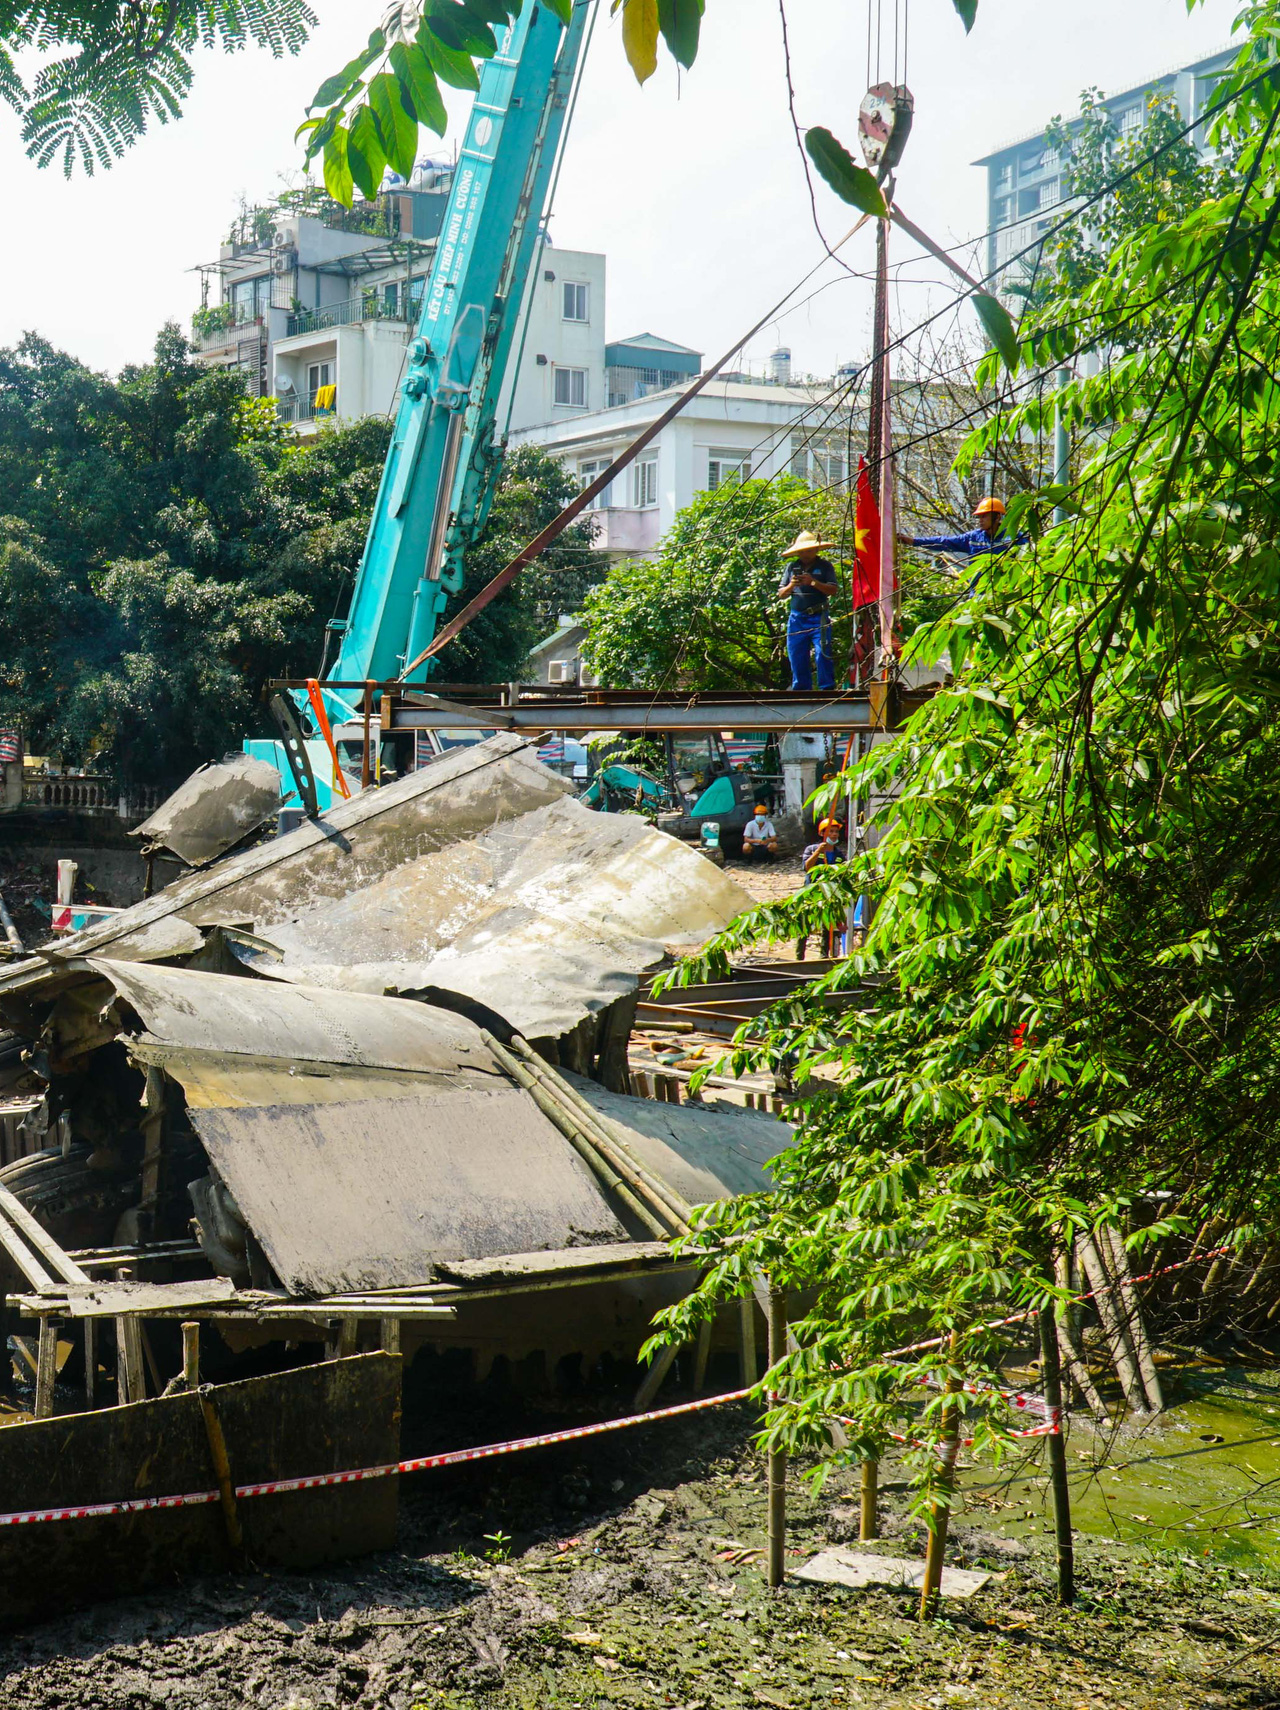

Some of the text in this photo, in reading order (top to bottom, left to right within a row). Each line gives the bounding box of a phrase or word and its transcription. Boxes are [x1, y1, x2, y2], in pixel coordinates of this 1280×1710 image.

[447, 213, 462, 244] MINH
[439, 244, 453, 272] THÉP
[433, 274, 447, 298] CẤU
[428, 299, 441, 321] KẾT
